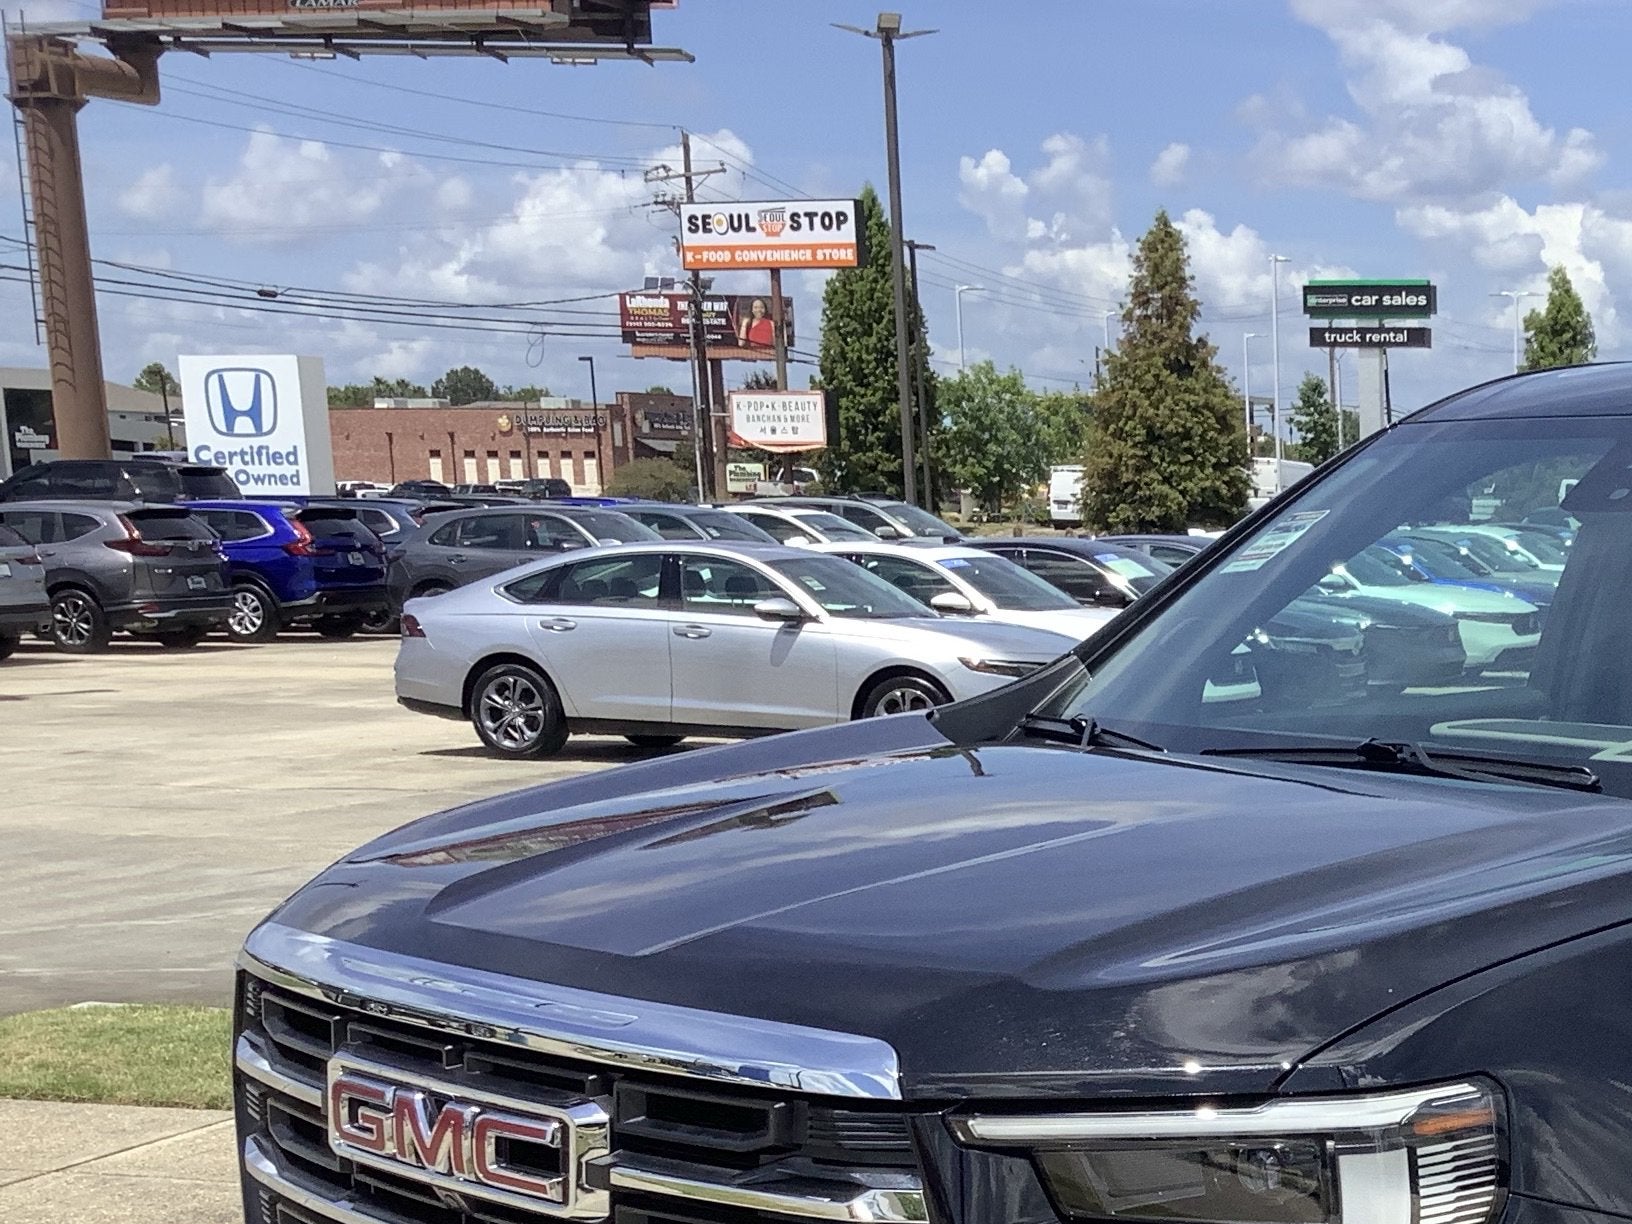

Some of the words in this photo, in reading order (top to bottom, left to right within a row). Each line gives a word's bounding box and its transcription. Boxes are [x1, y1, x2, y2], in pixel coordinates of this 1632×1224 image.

[687, 212, 756, 235] SEOUL
[789, 211, 849, 232] STOP
[686, 251, 732, 263] K-FOOD
[734, 250, 813, 262] CONVENIENCE
[816, 248, 854, 261] STORE
[1351, 294, 1379, 306] car
[1382, 290, 1427, 306] sales
[1324, 329, 1361, 342] truck
[1366, 329, 1408, 342] rental
[771, 400, 818, 412] K-BEAUTY
[746, 414, 780, 423] BANCHAN
[790, 414, 811, 423] MORE
[194, 444, 299, 466] Certified
[331, 1072, 566, 1203] GMC
